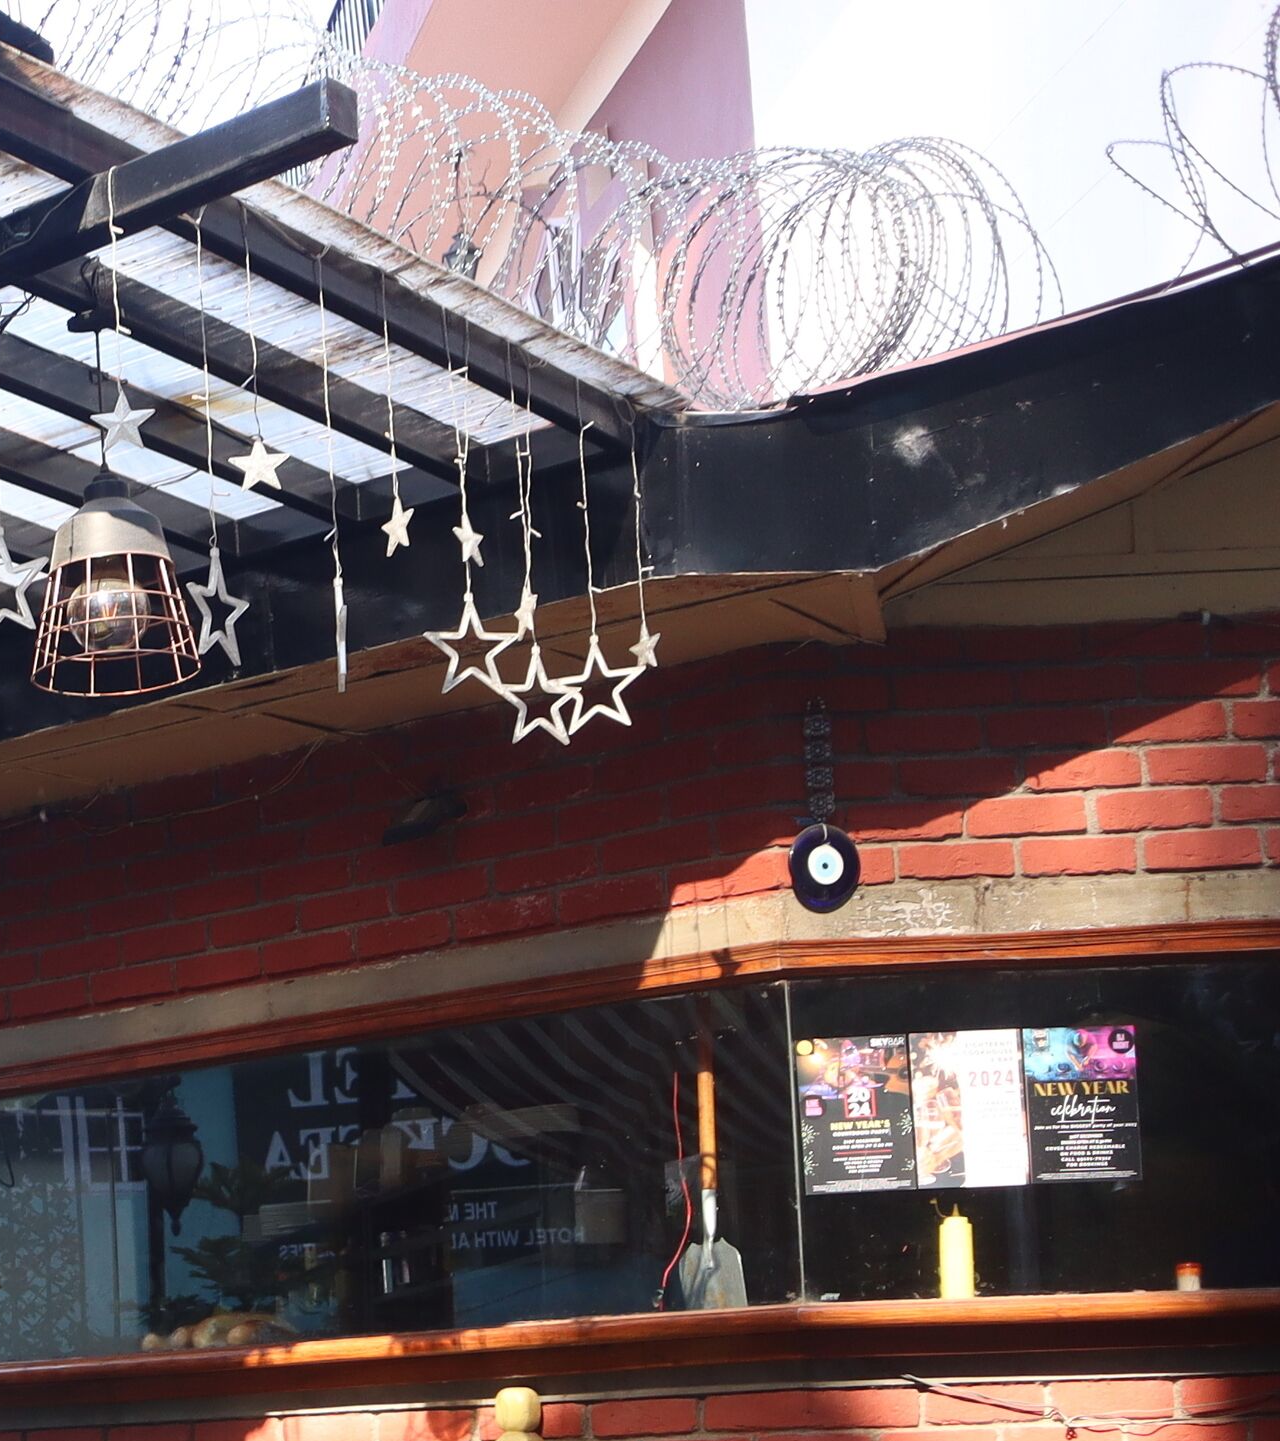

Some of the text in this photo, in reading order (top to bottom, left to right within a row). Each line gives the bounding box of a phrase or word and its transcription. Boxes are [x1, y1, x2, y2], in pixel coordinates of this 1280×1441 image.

[969, 1070, 1014, 1087] 2024
[1034, 1080, 1130, 1097] NEW YEAR
[1050, 1094, 1116, 1124] celebration
[830, 1119, 890, 1131] NEW YEAR'S
